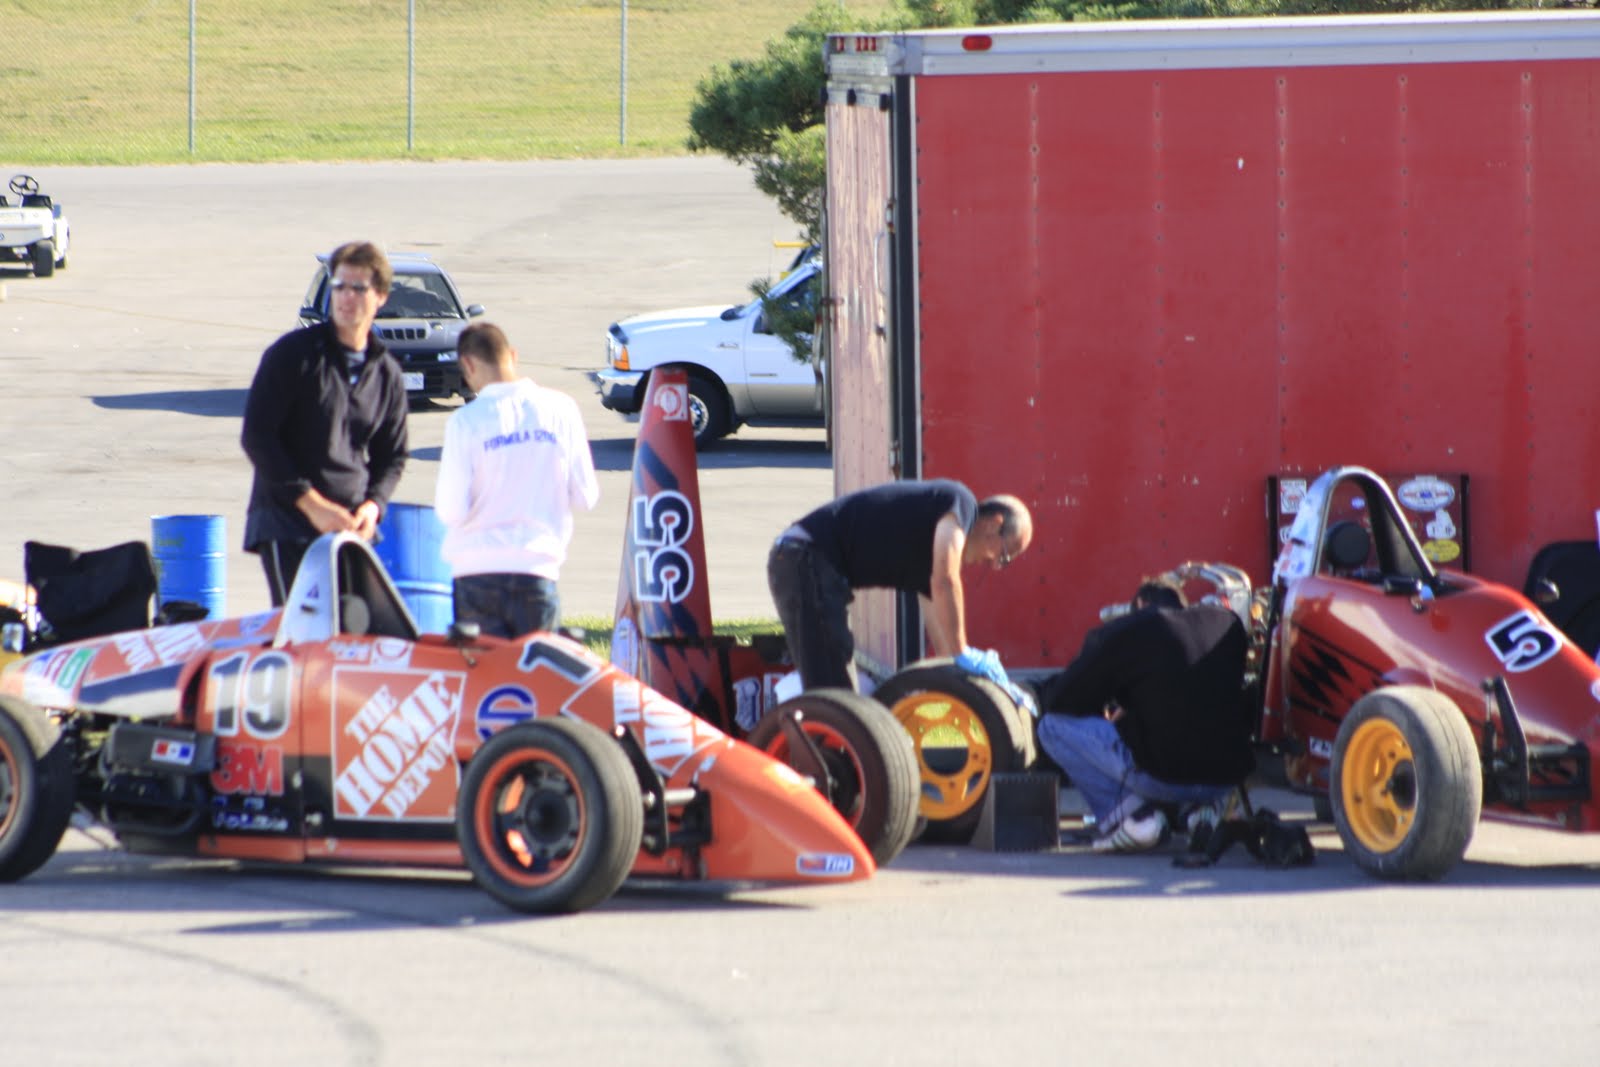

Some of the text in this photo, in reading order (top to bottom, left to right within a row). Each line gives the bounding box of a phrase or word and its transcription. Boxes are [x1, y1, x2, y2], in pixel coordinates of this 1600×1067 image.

[483, 429, 530, 452] FORMULA
[1484, 609, 1562, 673] 5
[210, 651, 292, 737] 19
[345, 685, 397, 744] THE
[210, 744, 285, 796] 3M
[334, 670, 458, 820] HOME
[382, 726, 454, 820] DEPOT
